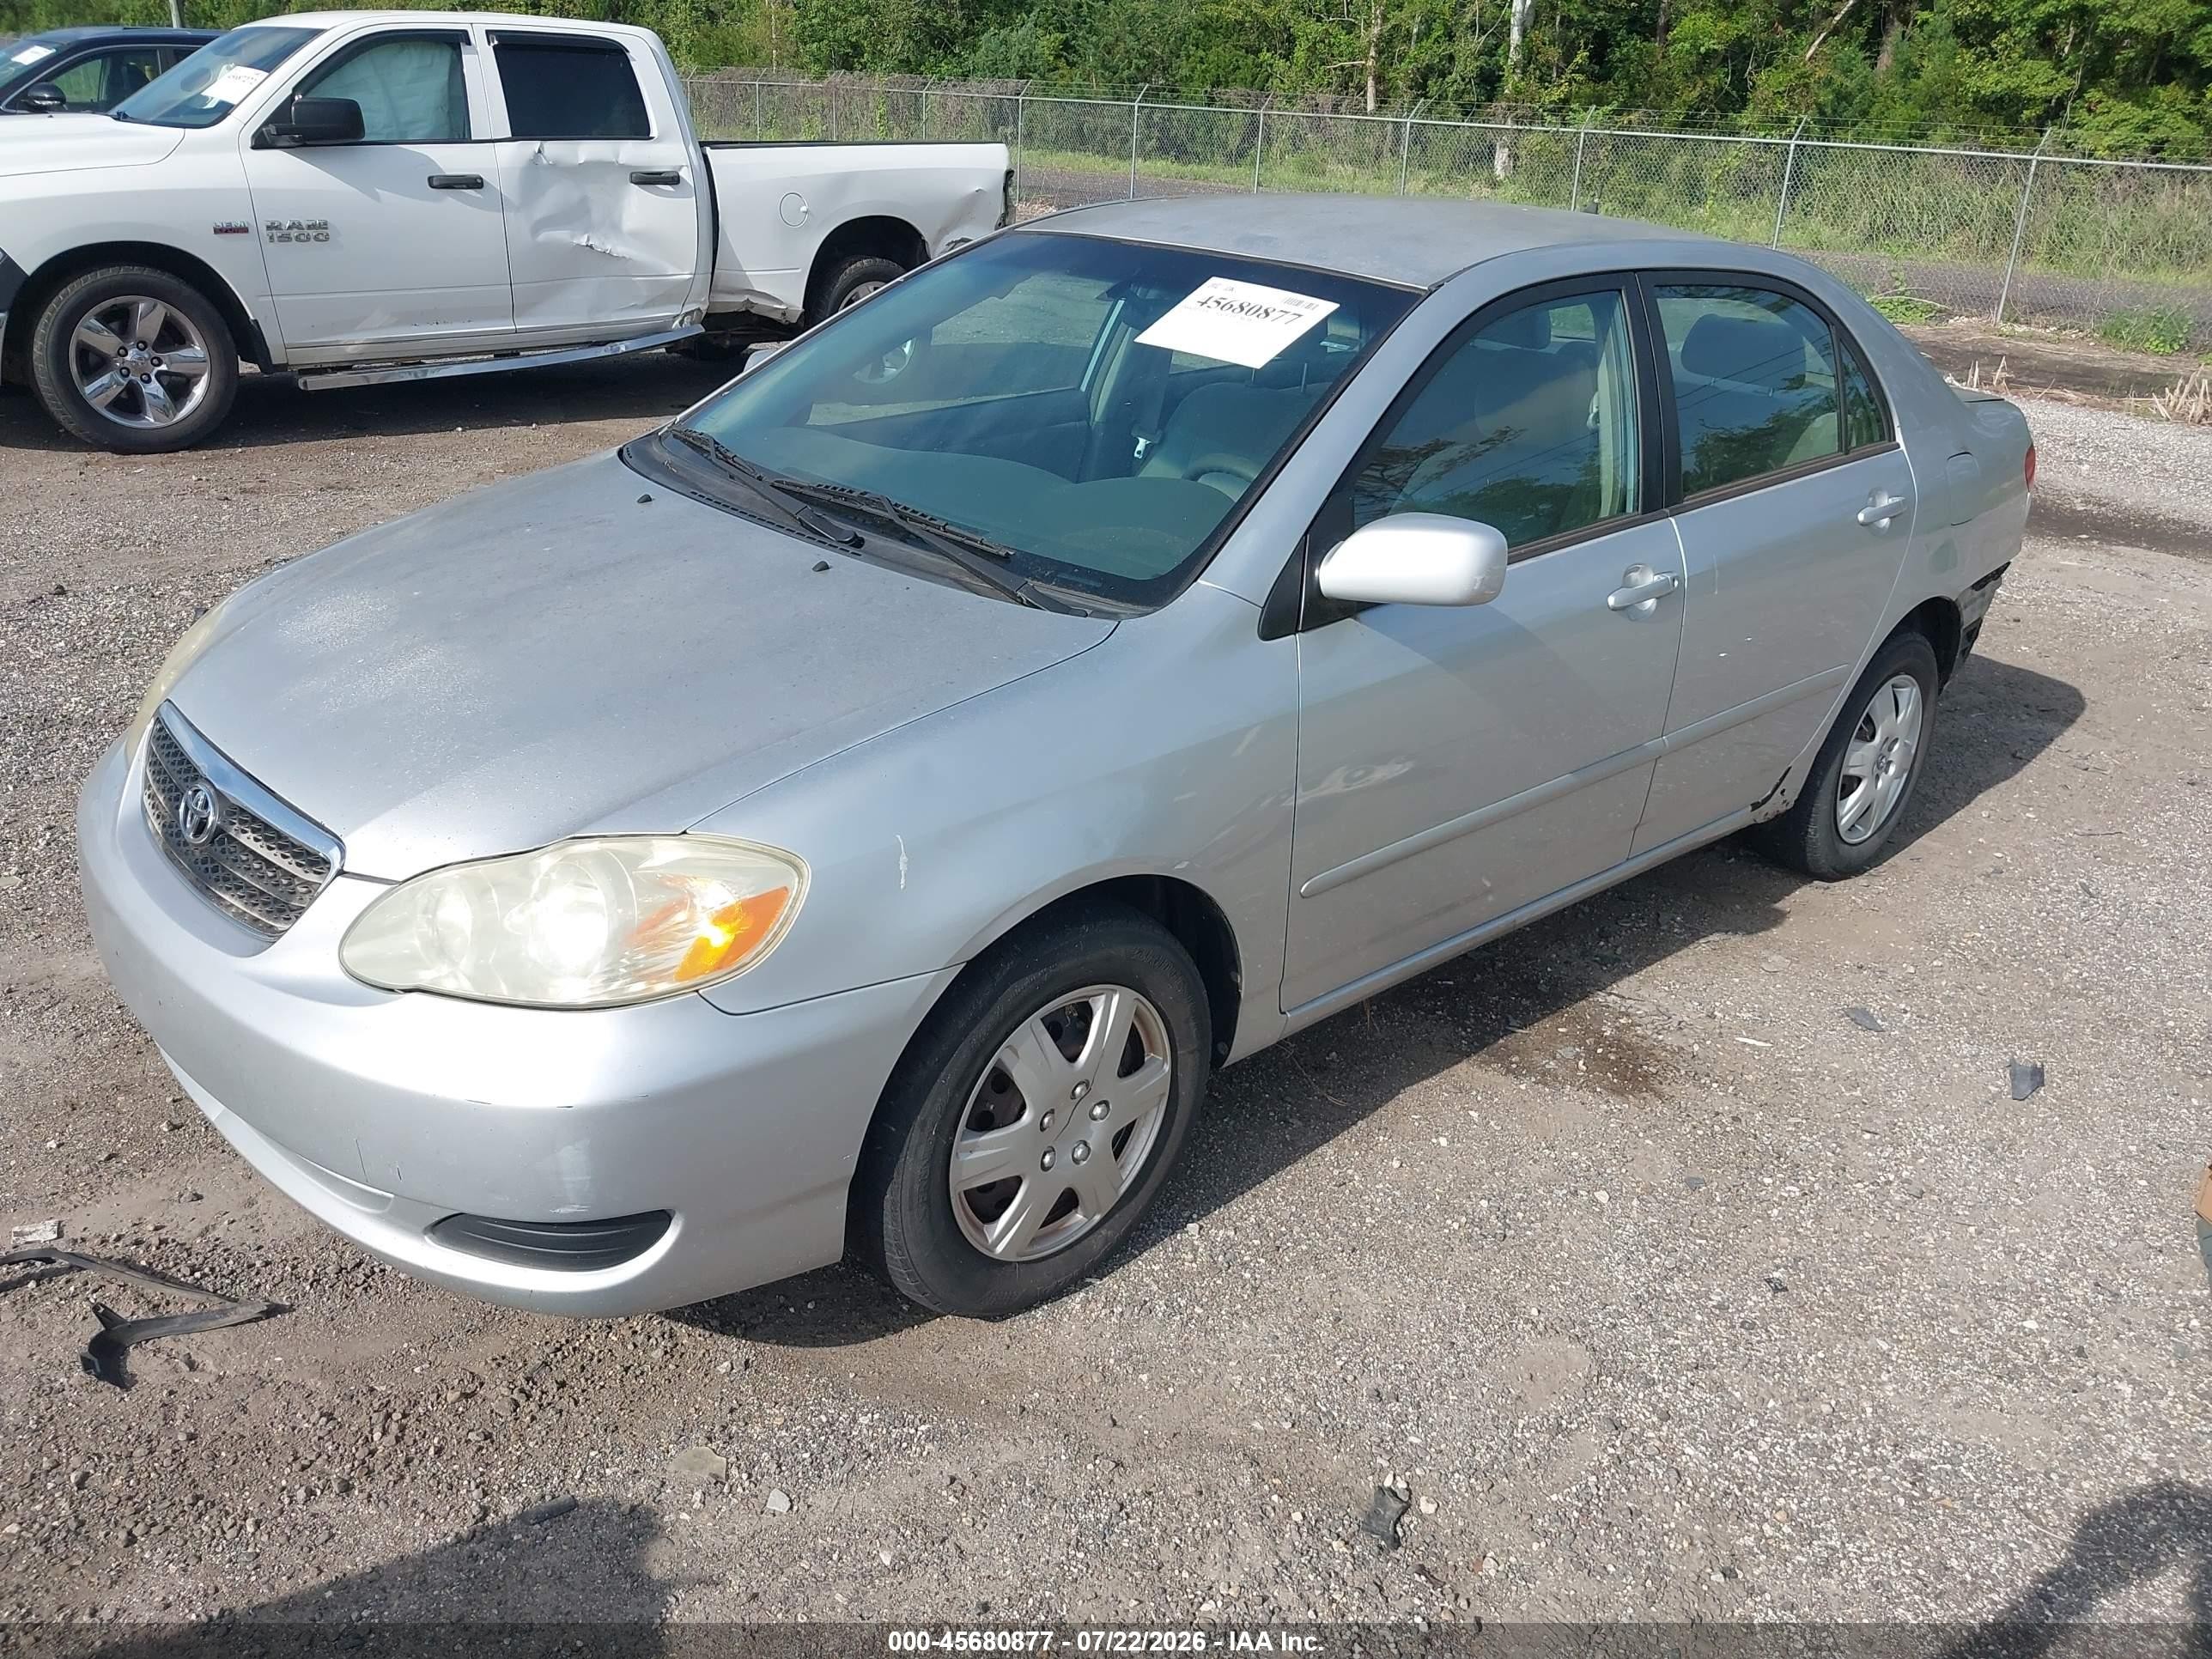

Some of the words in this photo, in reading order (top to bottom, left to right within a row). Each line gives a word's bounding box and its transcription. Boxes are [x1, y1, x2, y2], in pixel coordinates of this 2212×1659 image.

[265, 220, 329, 231] RAM
[266, 232, 330, 243] 1500
[1196, 295, 1304, 325] 45680877
